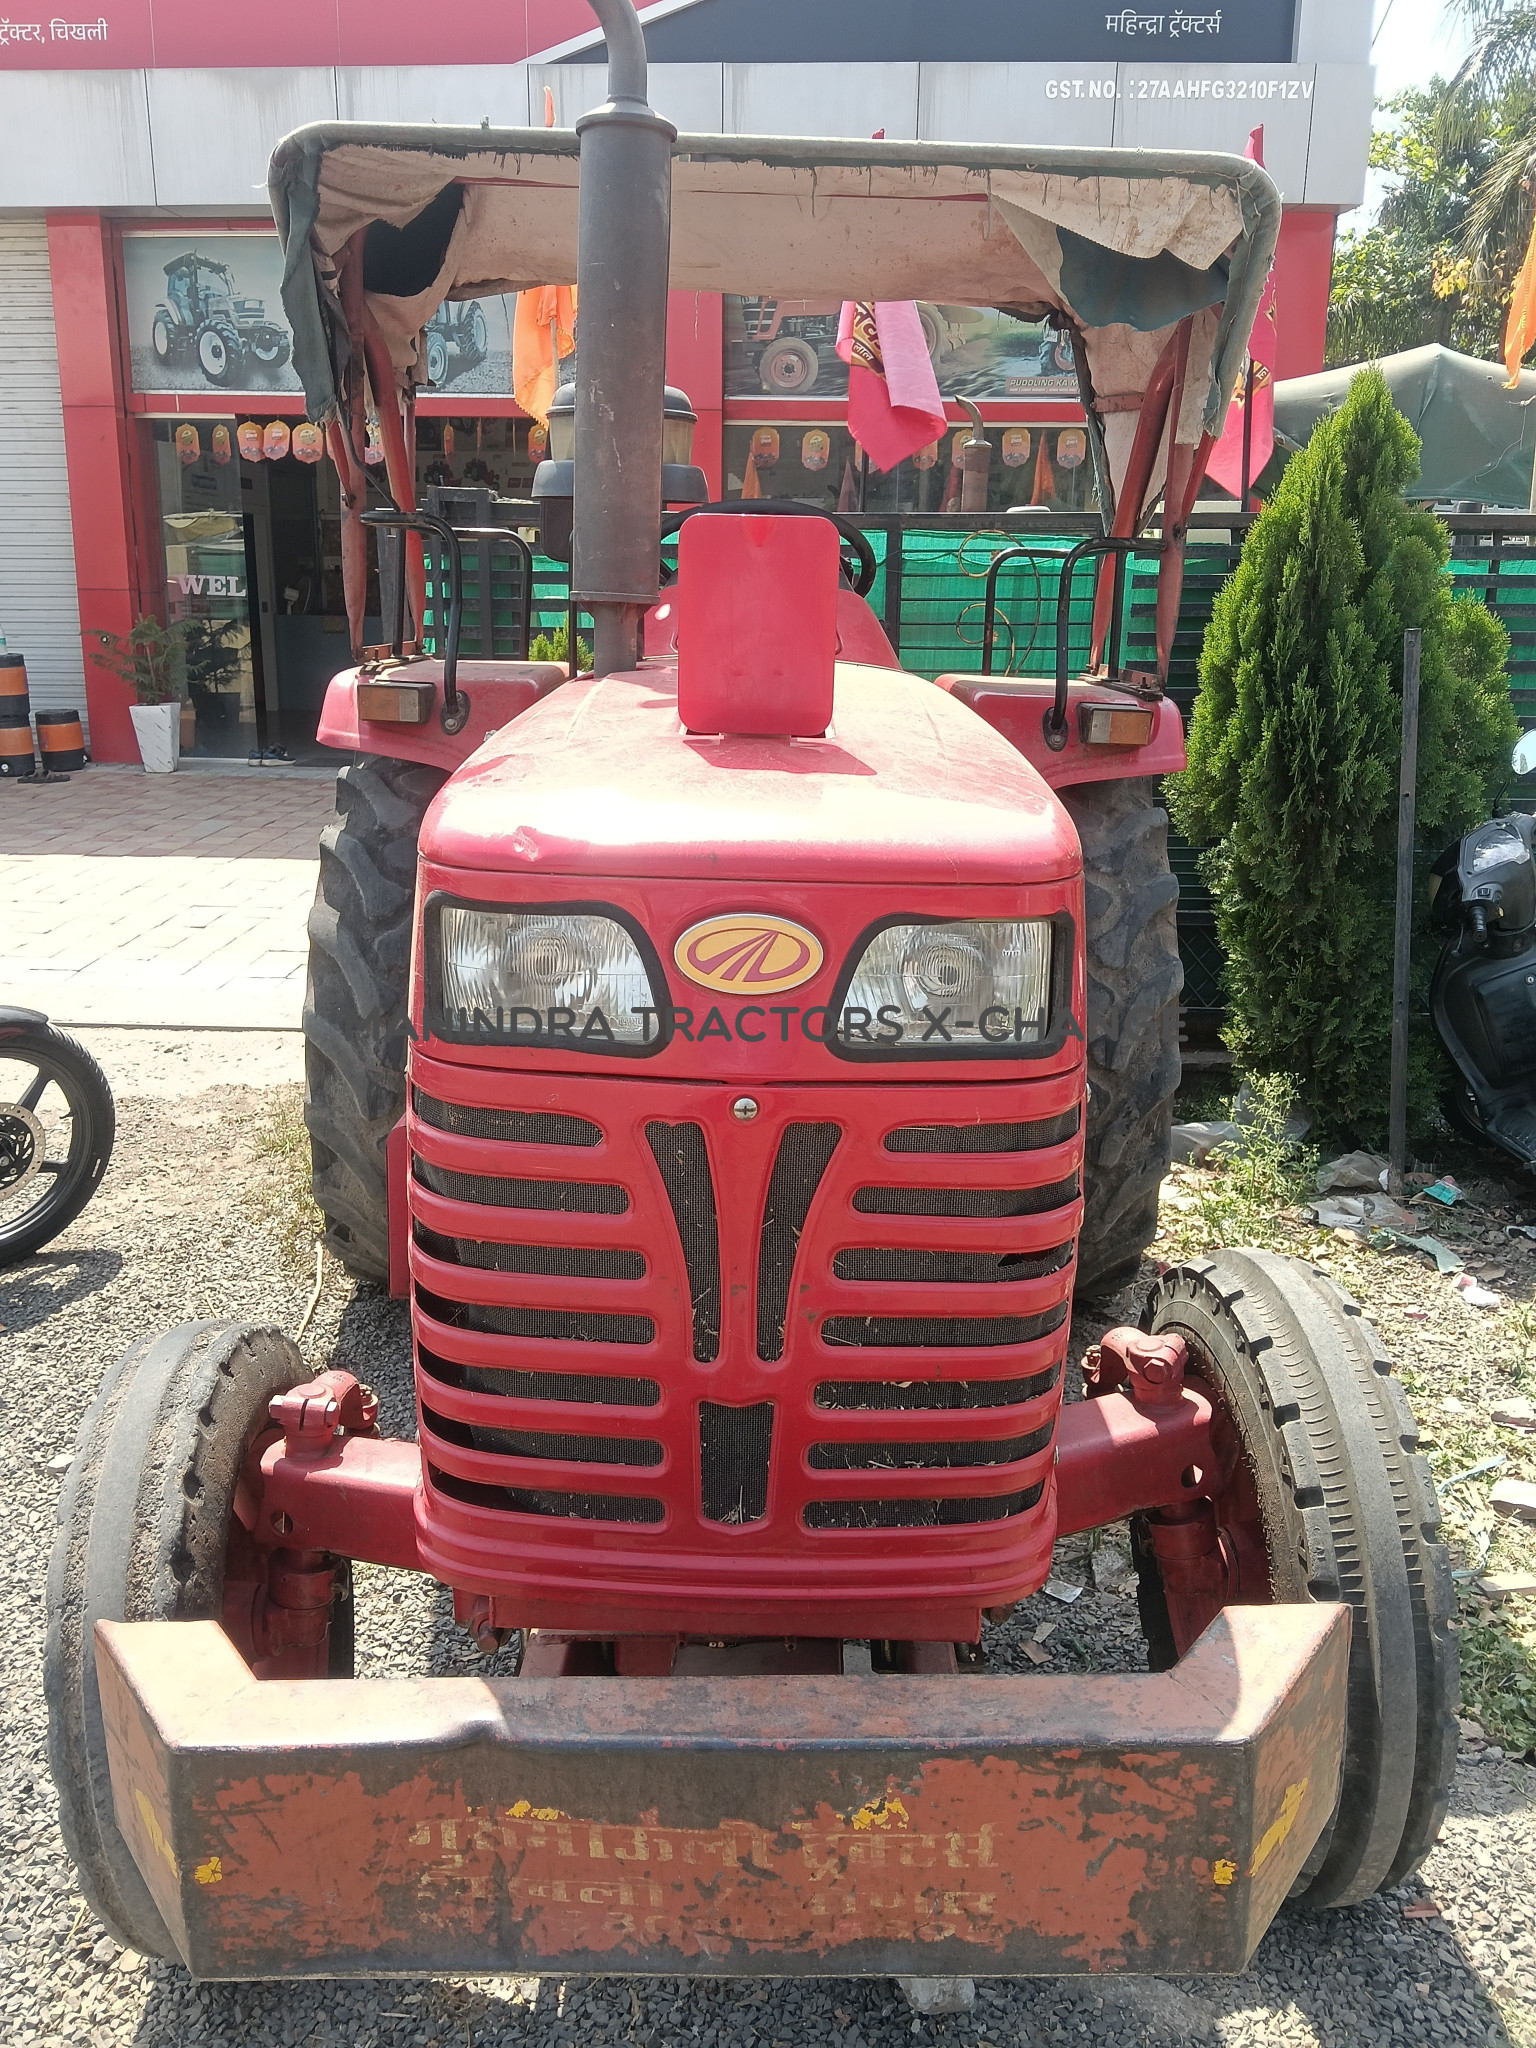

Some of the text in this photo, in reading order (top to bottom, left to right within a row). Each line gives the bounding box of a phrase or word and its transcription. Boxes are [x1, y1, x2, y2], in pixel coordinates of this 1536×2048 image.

[49, 18, 107, 41] चिखली
[1105, 9, 1222, 38] महिन्द्रा ट्रॅक्टर्स
[1010, 379, 1054, 387] PUDDLING
[1056, 379, 1068, 387] KA
[176, 574, 246, 597] WEL
